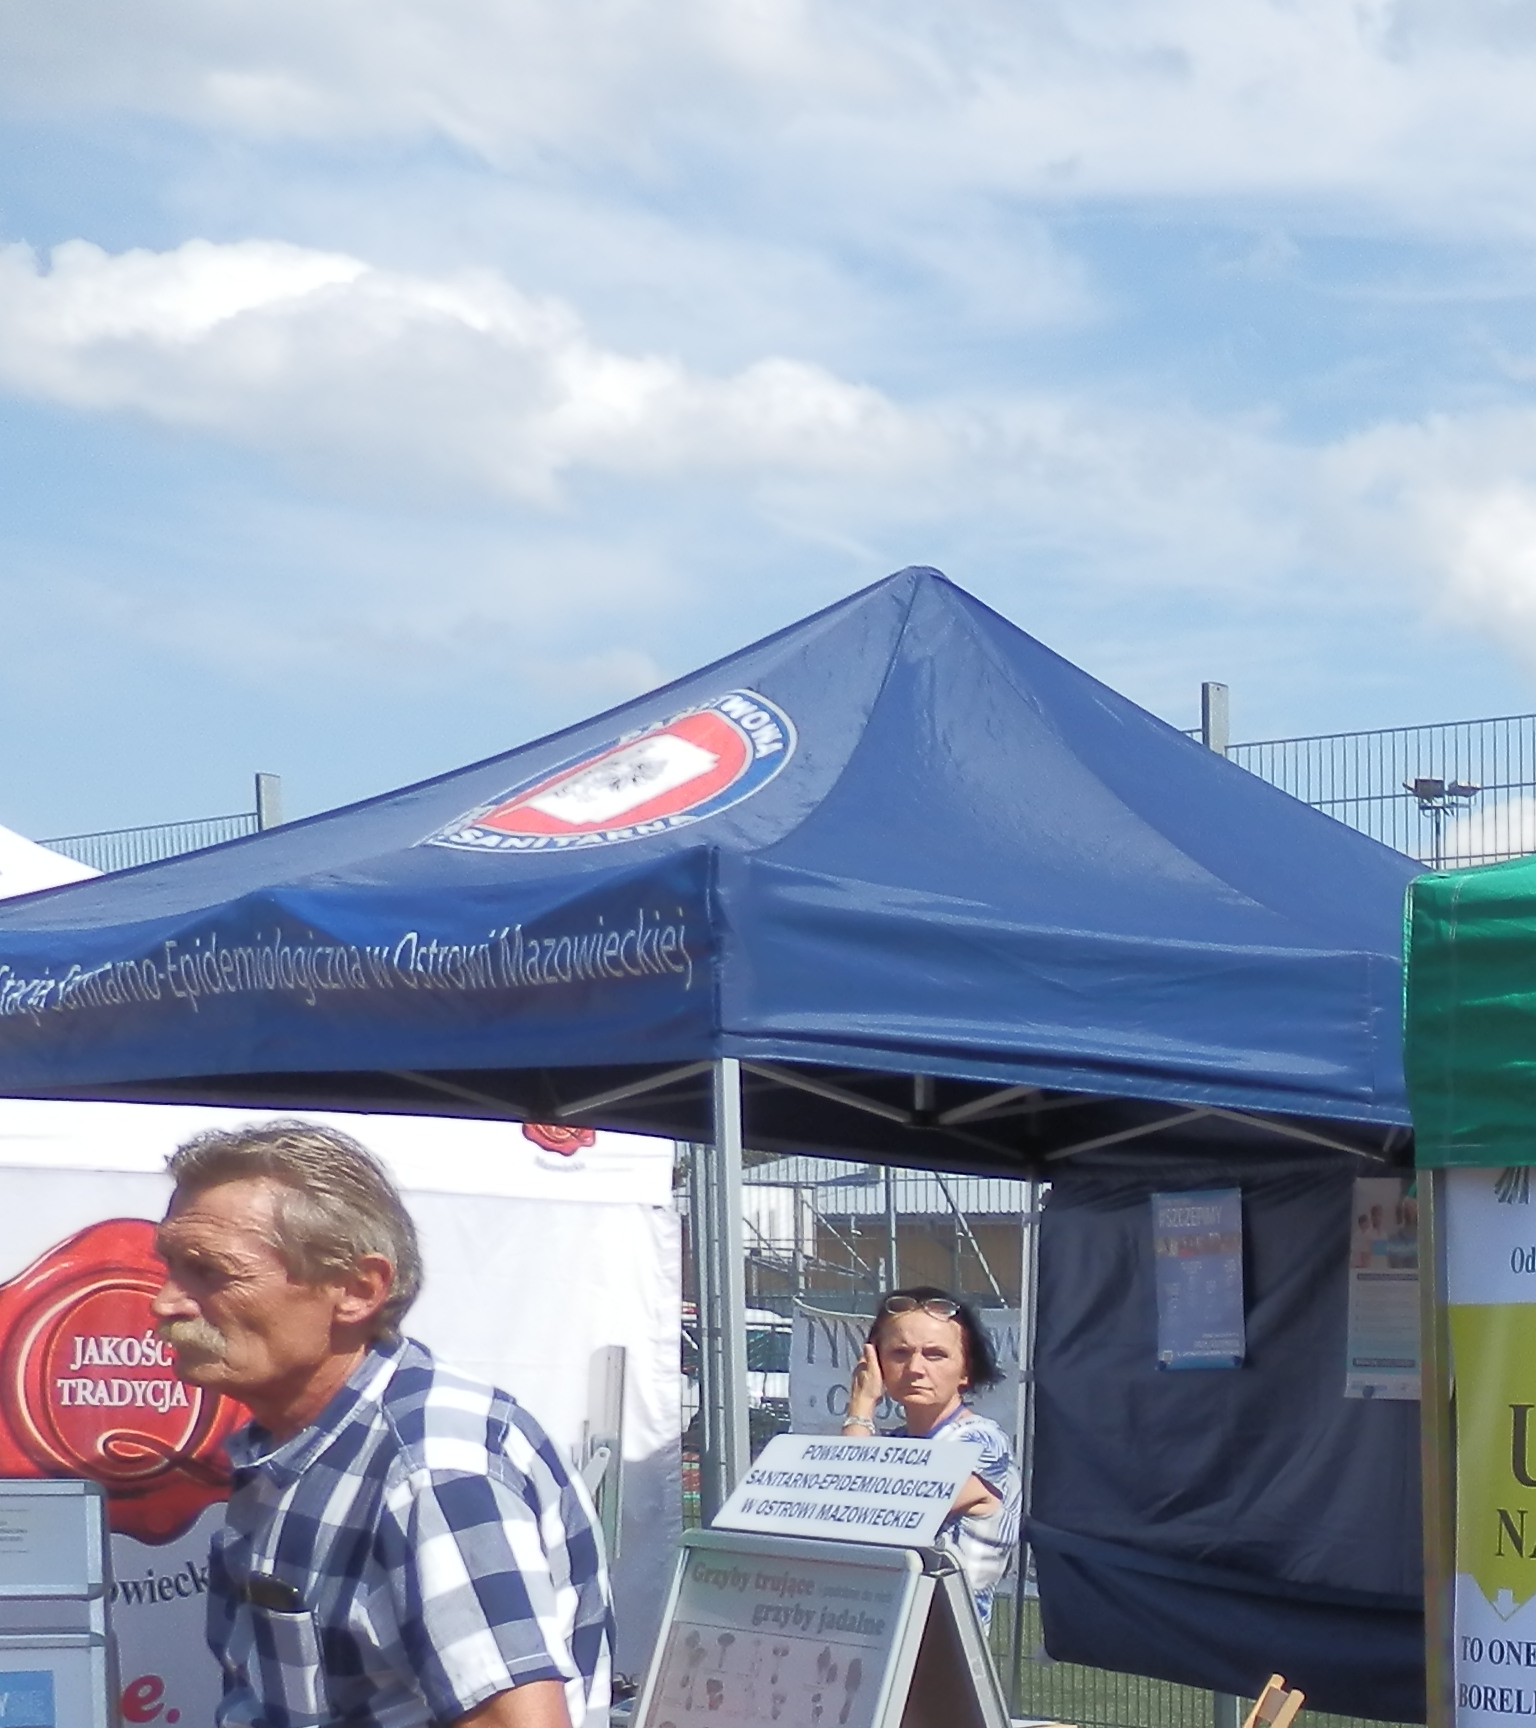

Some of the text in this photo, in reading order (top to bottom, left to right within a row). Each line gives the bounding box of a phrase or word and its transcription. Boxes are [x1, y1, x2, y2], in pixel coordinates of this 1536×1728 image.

[366, 944, 391, 988] w
[393, 925, 495, 990] Ostrowi
[499, 907, 693, 991] Mazowieckiej
[57, 1378, 189, 1413] TRADYCJA
[801, 1444, 932, 1466] POWIATOWA STACJA
[746, 1469, 955, 1500] SANITARNO-EPIDEMIOLOGICZNA
[740, 1498, 924, 1529] W OSTROWI MAZOWIECKIEJ
[1462, 1636, 1483, 1663] TO
